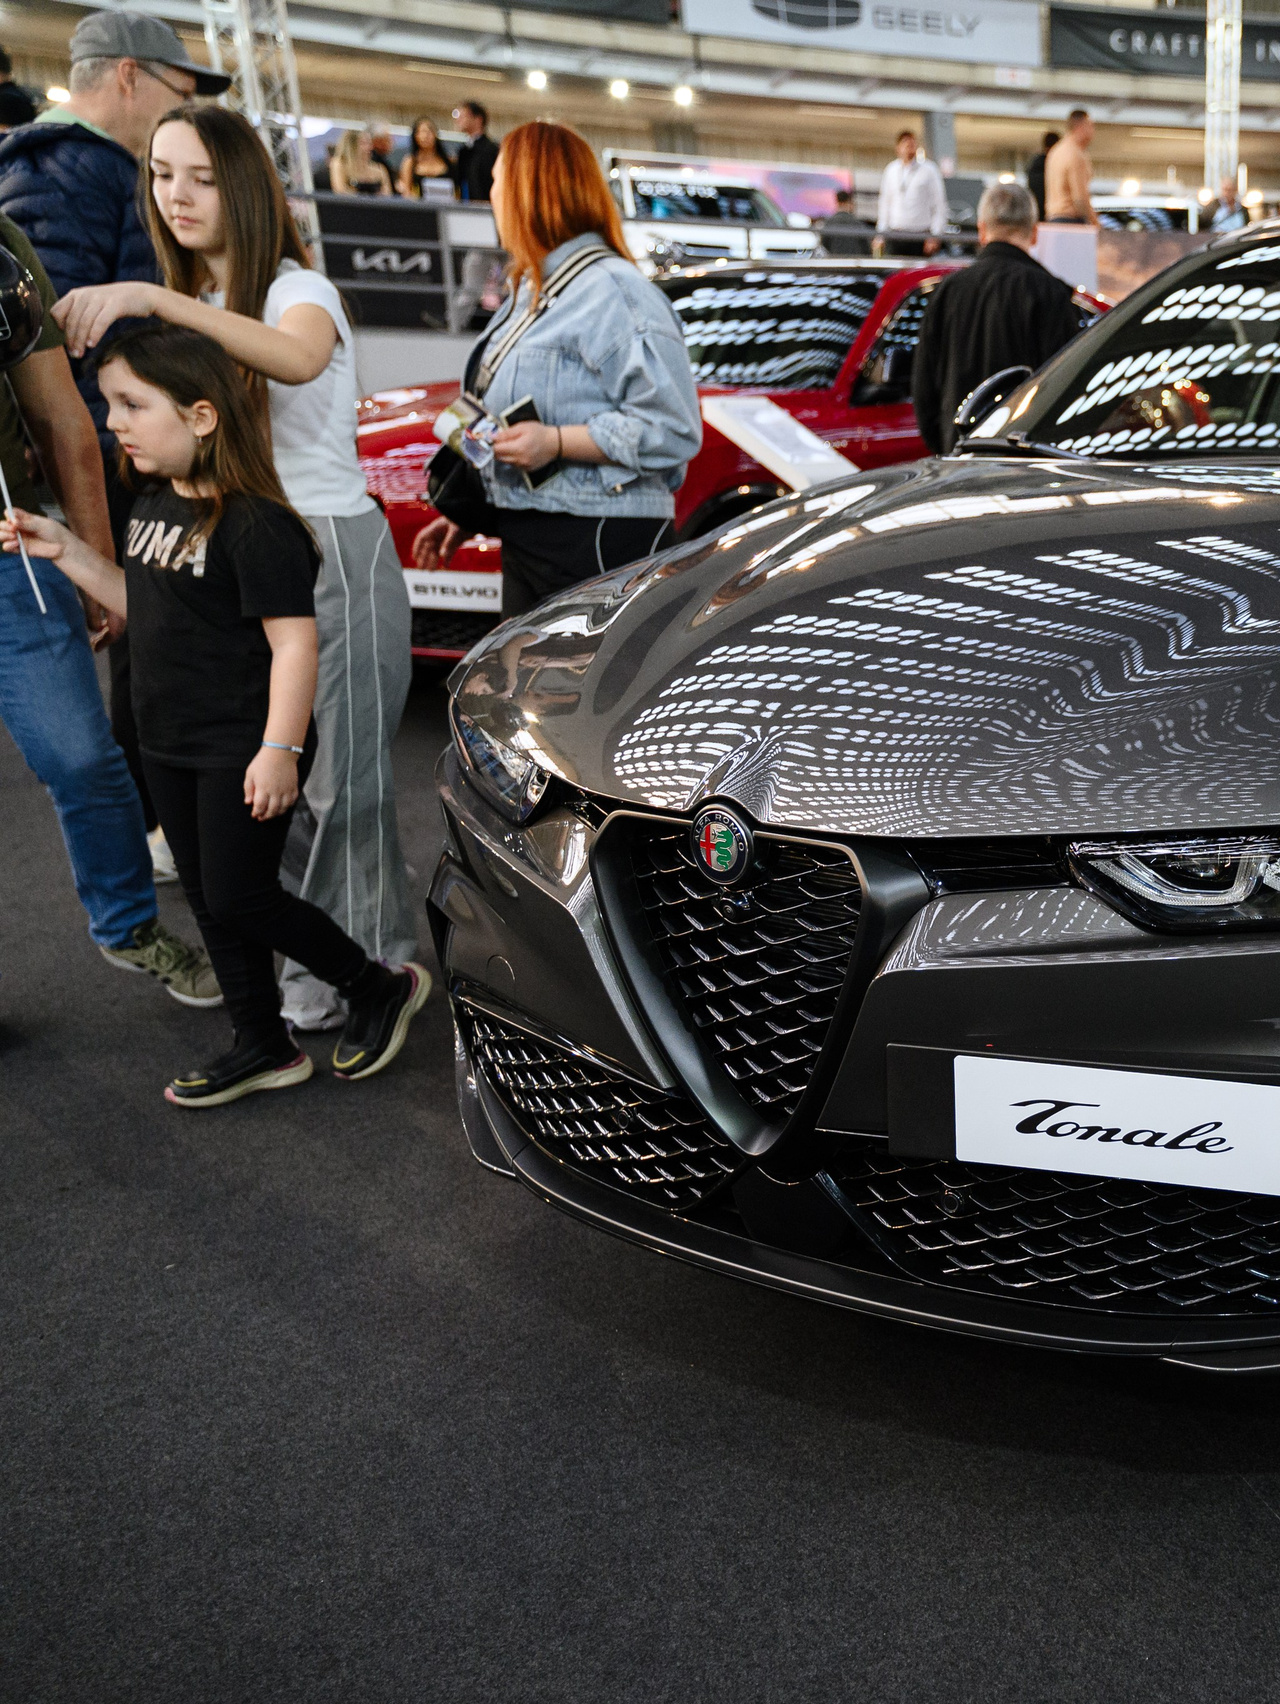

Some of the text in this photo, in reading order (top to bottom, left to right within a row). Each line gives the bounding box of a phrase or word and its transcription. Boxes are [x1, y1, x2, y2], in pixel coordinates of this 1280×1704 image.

[873, 5, 982, 38] GEELY
[1108, 28, 1207, 58] CRAFT
[351, 248, 432, 273] KIA
[413, 583, 498, 599] STELVIO
[694, 813, 745, 852] ALFA ROMEO
[1009, 1099, 1234, 1154] Tonale
